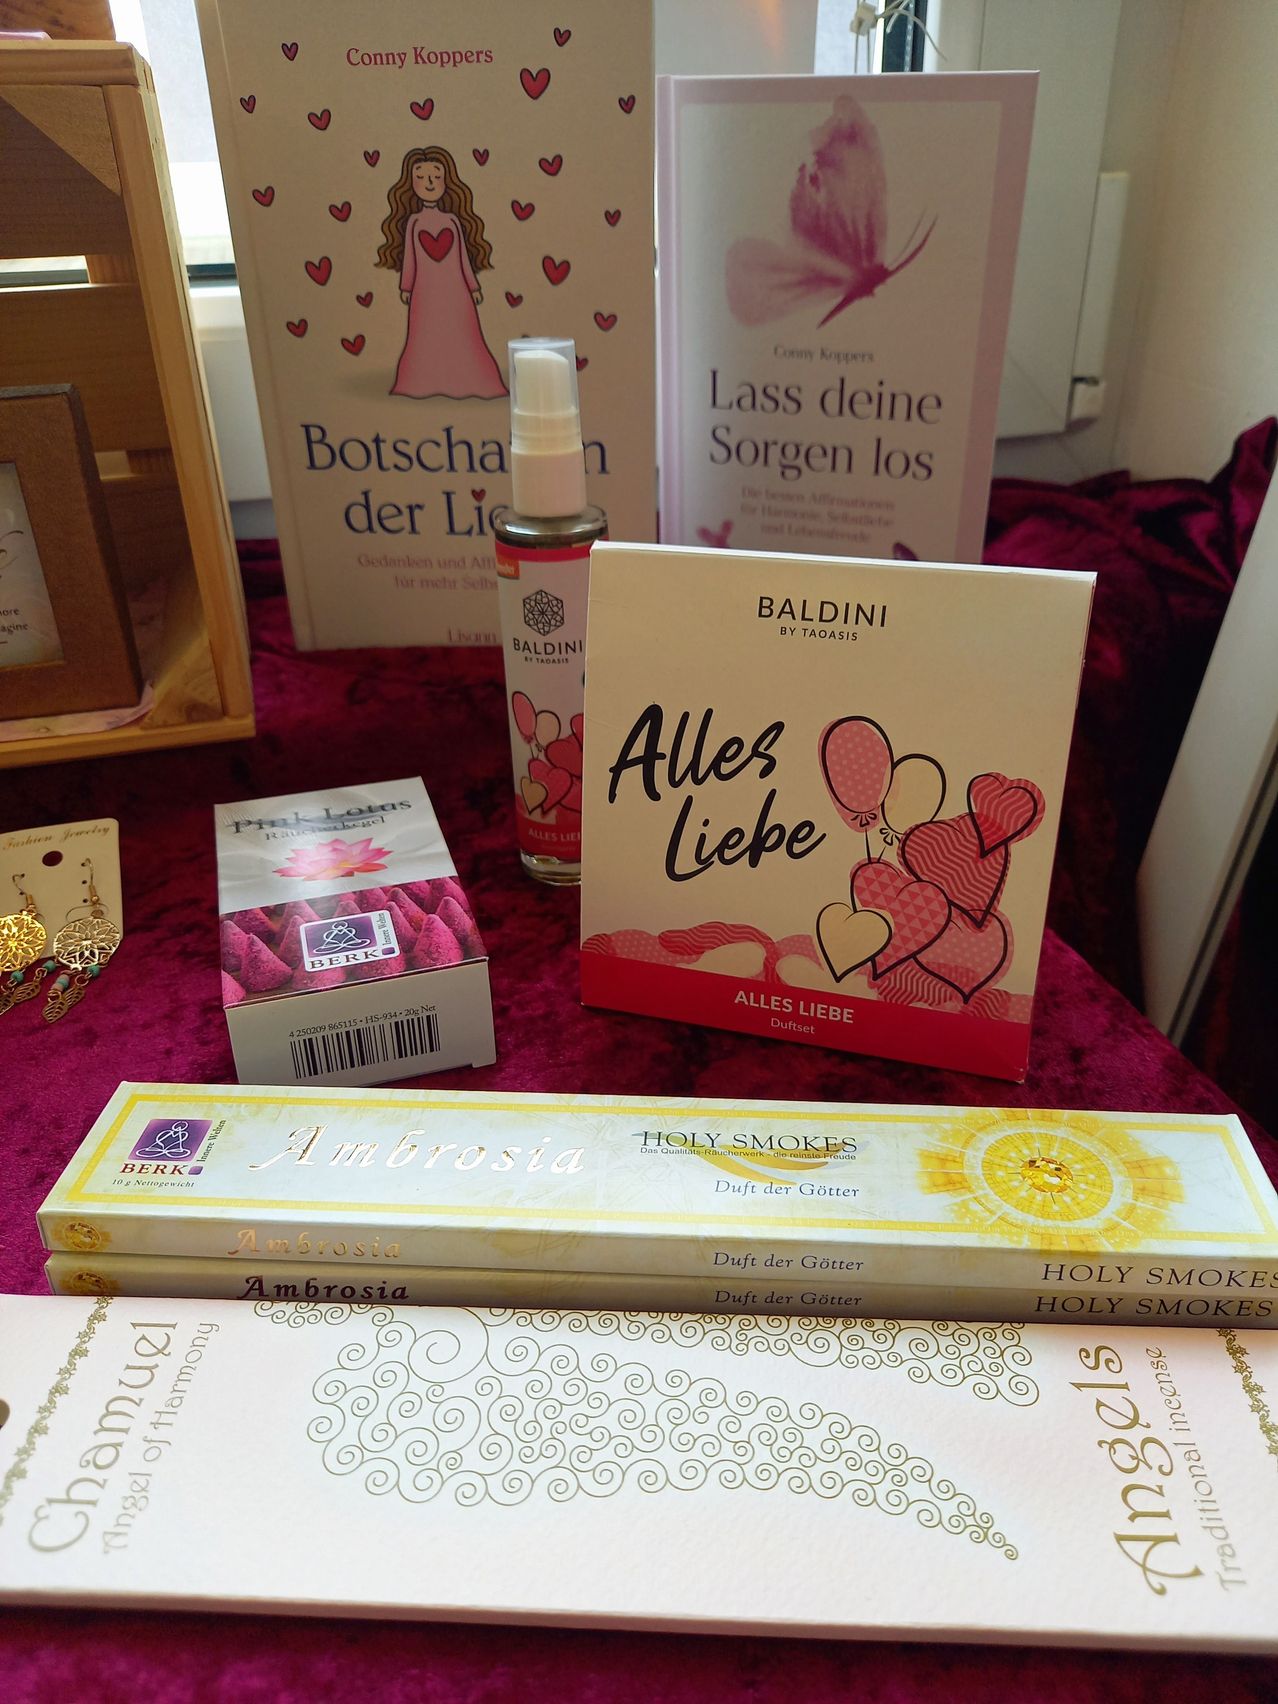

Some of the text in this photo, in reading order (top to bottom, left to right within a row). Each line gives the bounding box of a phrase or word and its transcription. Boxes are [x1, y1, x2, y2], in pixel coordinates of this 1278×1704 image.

[346, 46, 494, 68] Conny Koppers
[773, 344, 875, 364] Conny Koppers
[709, 369, 943, 424] Lass deine
[300, 423, 610, 475] Botschan
[709, 424, 934, 482] Sorgen los
[344, 489, 425, 536] der
[357, 554, 433, 569] Gedanken
[437, 556, 466, 569] und
[394, 575, 417, 589] für
[420, 576, 457, 590] mehr
[0, 606, 20, 617] ore
[757, 595, 889, 629] BALDINI
[0, 622, 29, 635] agine
[779, 626, 859, 642] BY TAOASIS
[513, 637, 583, 656] BALDINI
[536, 657, 569, 665] TAOASIS
[608, 703, 785, 804] Alles
[528, 827, 581, 842] ALLES LIE
[665, 788, 827, 882] Liebe
[309, 949, 380, 970] BERK
[734, 990, 855, 1024] ALLES LIEBE
[296, 1025, 327, 1038] 250209
[328, 1018, 358, 1031] 865115
[365, 1011, 398, 1024] HS-934
[404, 1008, 420, 1018] 20g
[421, 1004, 436, 1013] Net
[770, 1017, 816, 1034] Duftset
[197, 1119, 227, 1163] Innere Welten
[247, 1122, 586, 1174] Ambrosia
[640, 1147, 658, 1155] Das
[641, 1130, 858, 1153] HOLY SMOKES
[120, 1162, 188, 1175] BERK
[134, 1179, 195, 1188] Nettogewicht
[715, 1179, 860, 1197] Duft der Götter
[227, 1229, 401, 1258] Ambrosia
[713, 1252, 864, 1271] Duft der Götter
[1041, 1263, 1134, 1284] HOLY
[236, 1275, 409, 1300] Ambrosia
[714, 1290, 862, 1307] Duft der Götter
[1034, 1296, 1273, 1317] HOLY SMOKES
[28, 1321, 178, 1553] Chamuel
[102, 1322, 220, 1554] Angel of Harmony
[1068, 1345, 1205, 1596] Angels
[1145, 1346, 1247, 1591] Traditional incense
